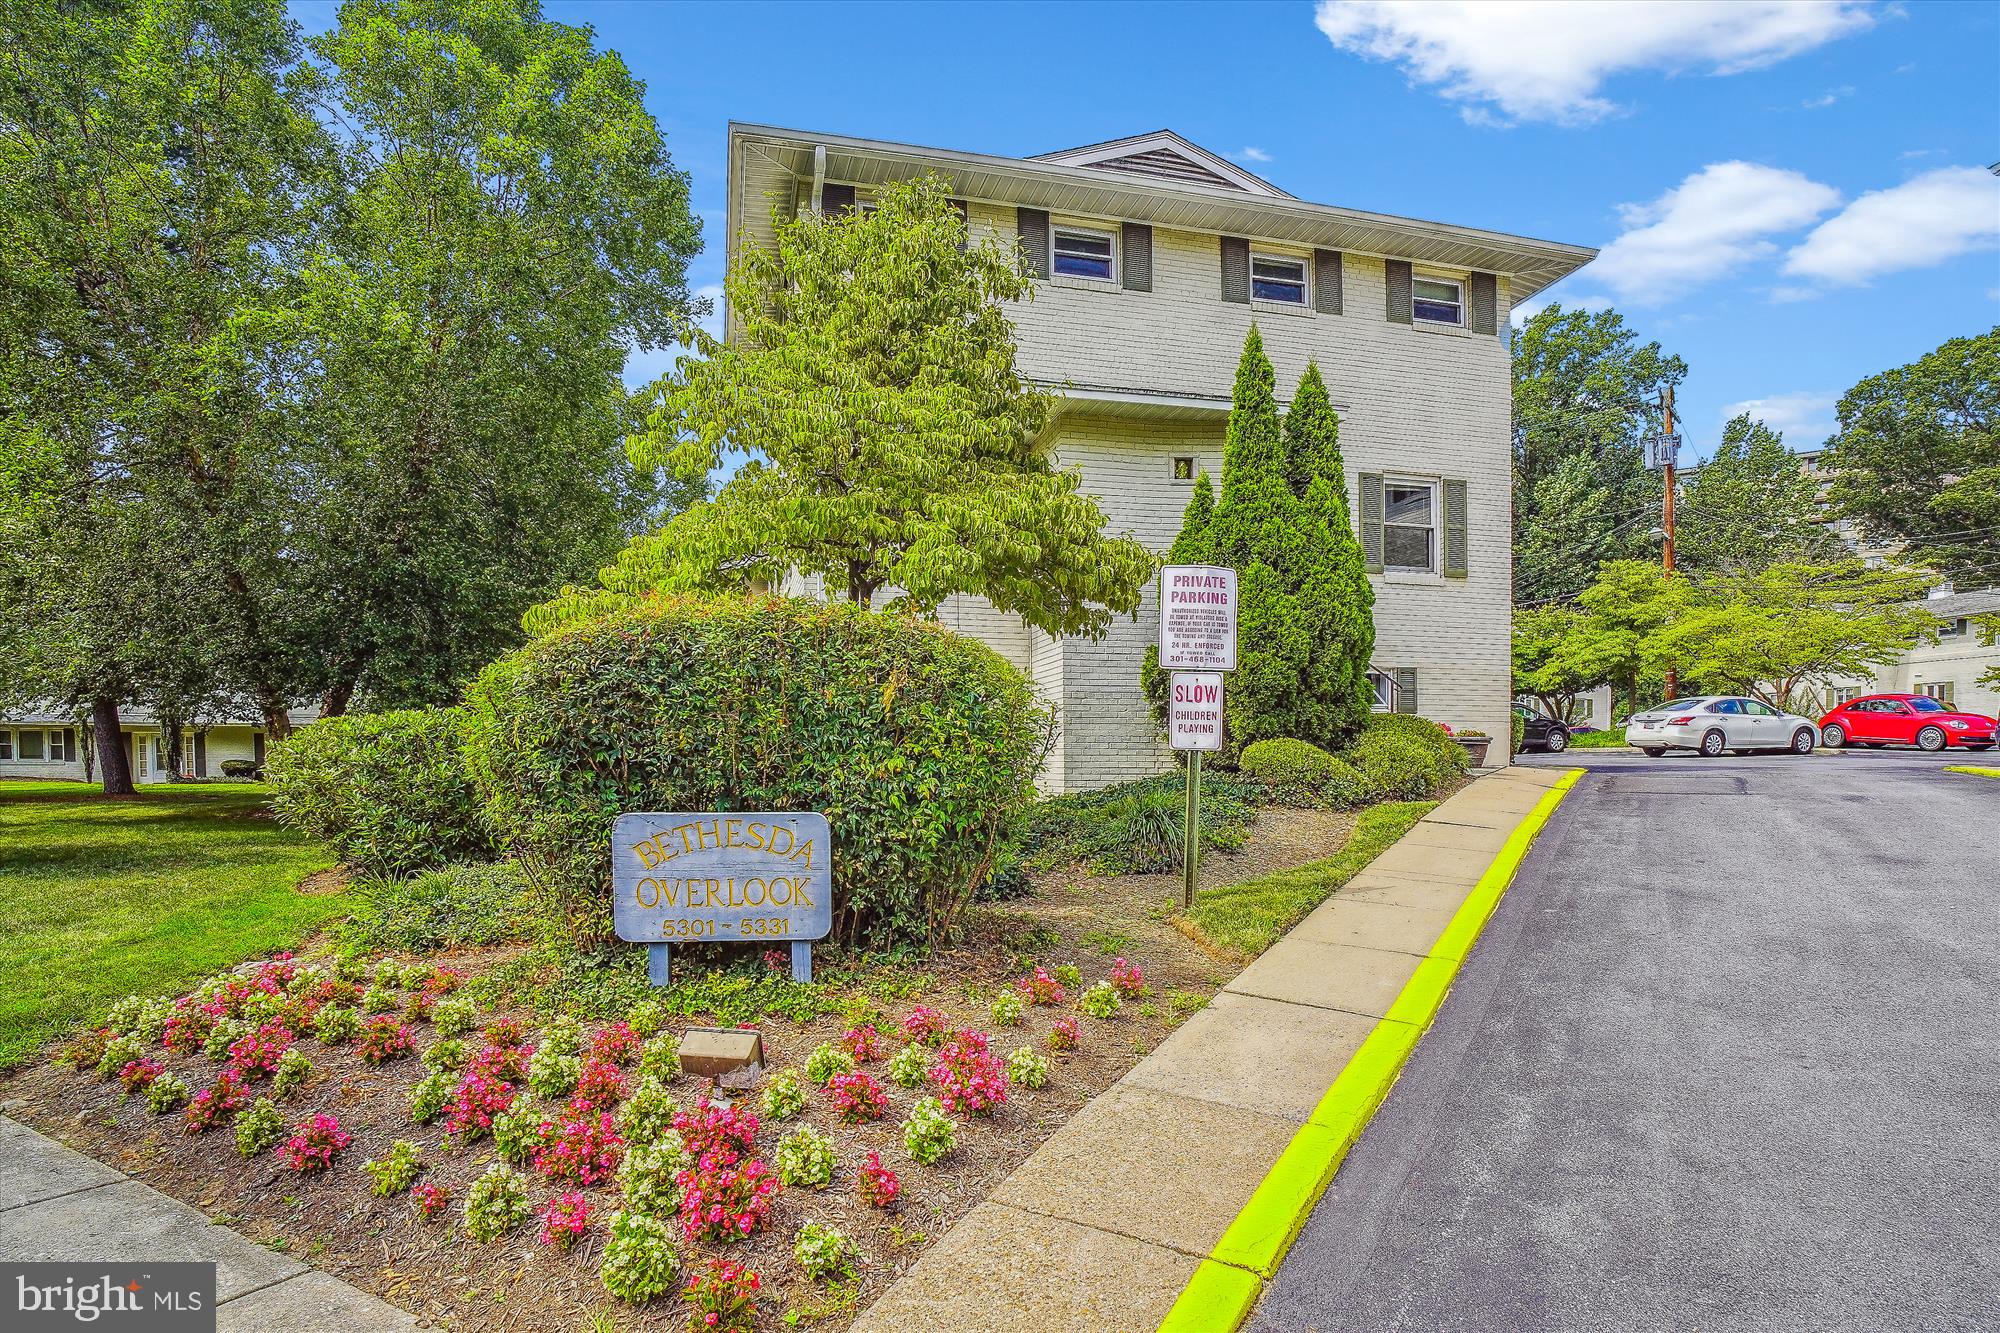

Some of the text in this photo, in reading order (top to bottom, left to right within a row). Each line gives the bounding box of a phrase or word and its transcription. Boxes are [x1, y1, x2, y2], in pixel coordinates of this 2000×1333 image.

[1173, 575, 1226, 589] PRIVATE
[1171, 591, 1228, 605] PARKING
[1171, 641, 1179, 649] 24
[1194, 642, 1225, 650] ENFORCED
[1169, 655, 1226, 664] 301-468-1104
[1175, 684, 1218, 703] SLOW
[1175, 710, 1217, 721] CHILDREN
[1178, 723, 1214, 734] PLAYING
[633, 818, 814, 871] BETHESDA
[636, 877, 814, 909] OVERLOOK
[662, 919, 716, 937] 5301
[740, 918, 790, 936] 5331
